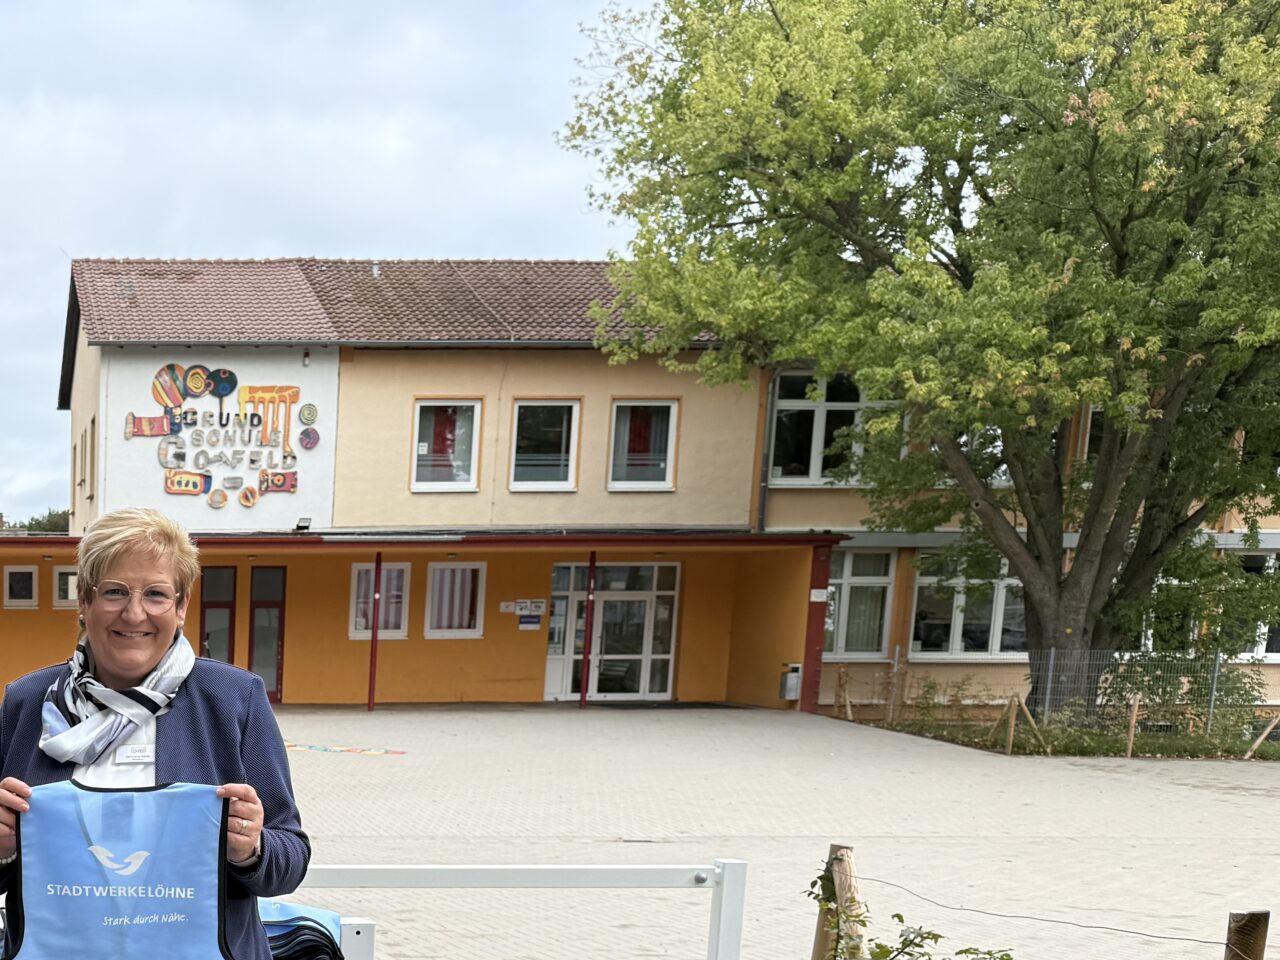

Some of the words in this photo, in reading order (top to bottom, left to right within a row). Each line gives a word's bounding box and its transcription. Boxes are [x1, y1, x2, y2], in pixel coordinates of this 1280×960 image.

[182, 408, 262, 428] GRUND
[102, 915, 131, 926] Stark
[133, 913, 159, 925] durch
